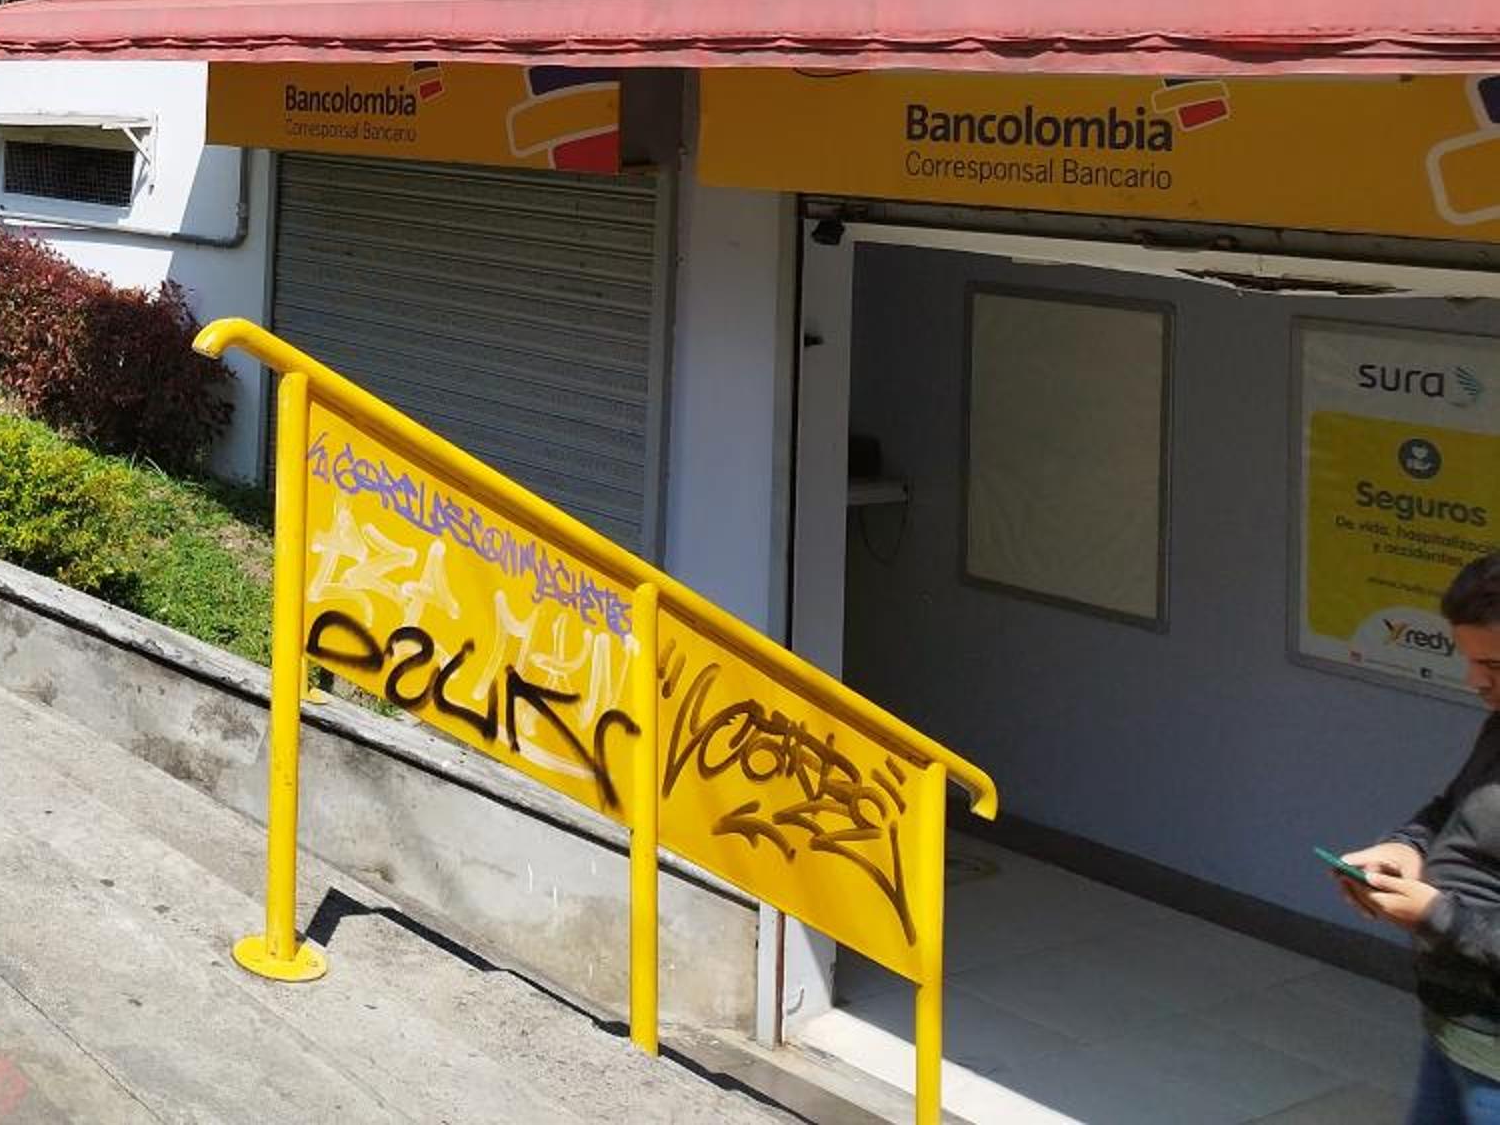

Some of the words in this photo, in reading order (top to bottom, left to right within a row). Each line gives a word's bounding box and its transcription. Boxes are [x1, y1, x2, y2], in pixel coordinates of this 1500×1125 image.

[285, 84, 417, 116] Bancolombia
[285, 118, 358, 139] Corresponsal
[363, 121, 417, 143] Bancario
[906, 104, 1173, 152] Bancolombia
[904, 150, 1053, 184] Corresponsal
[1062, 158, 1172, 190] Bancario
[1358, 364, 1445, 398] sura
[1356, 480, 1488, 527] Seguros
